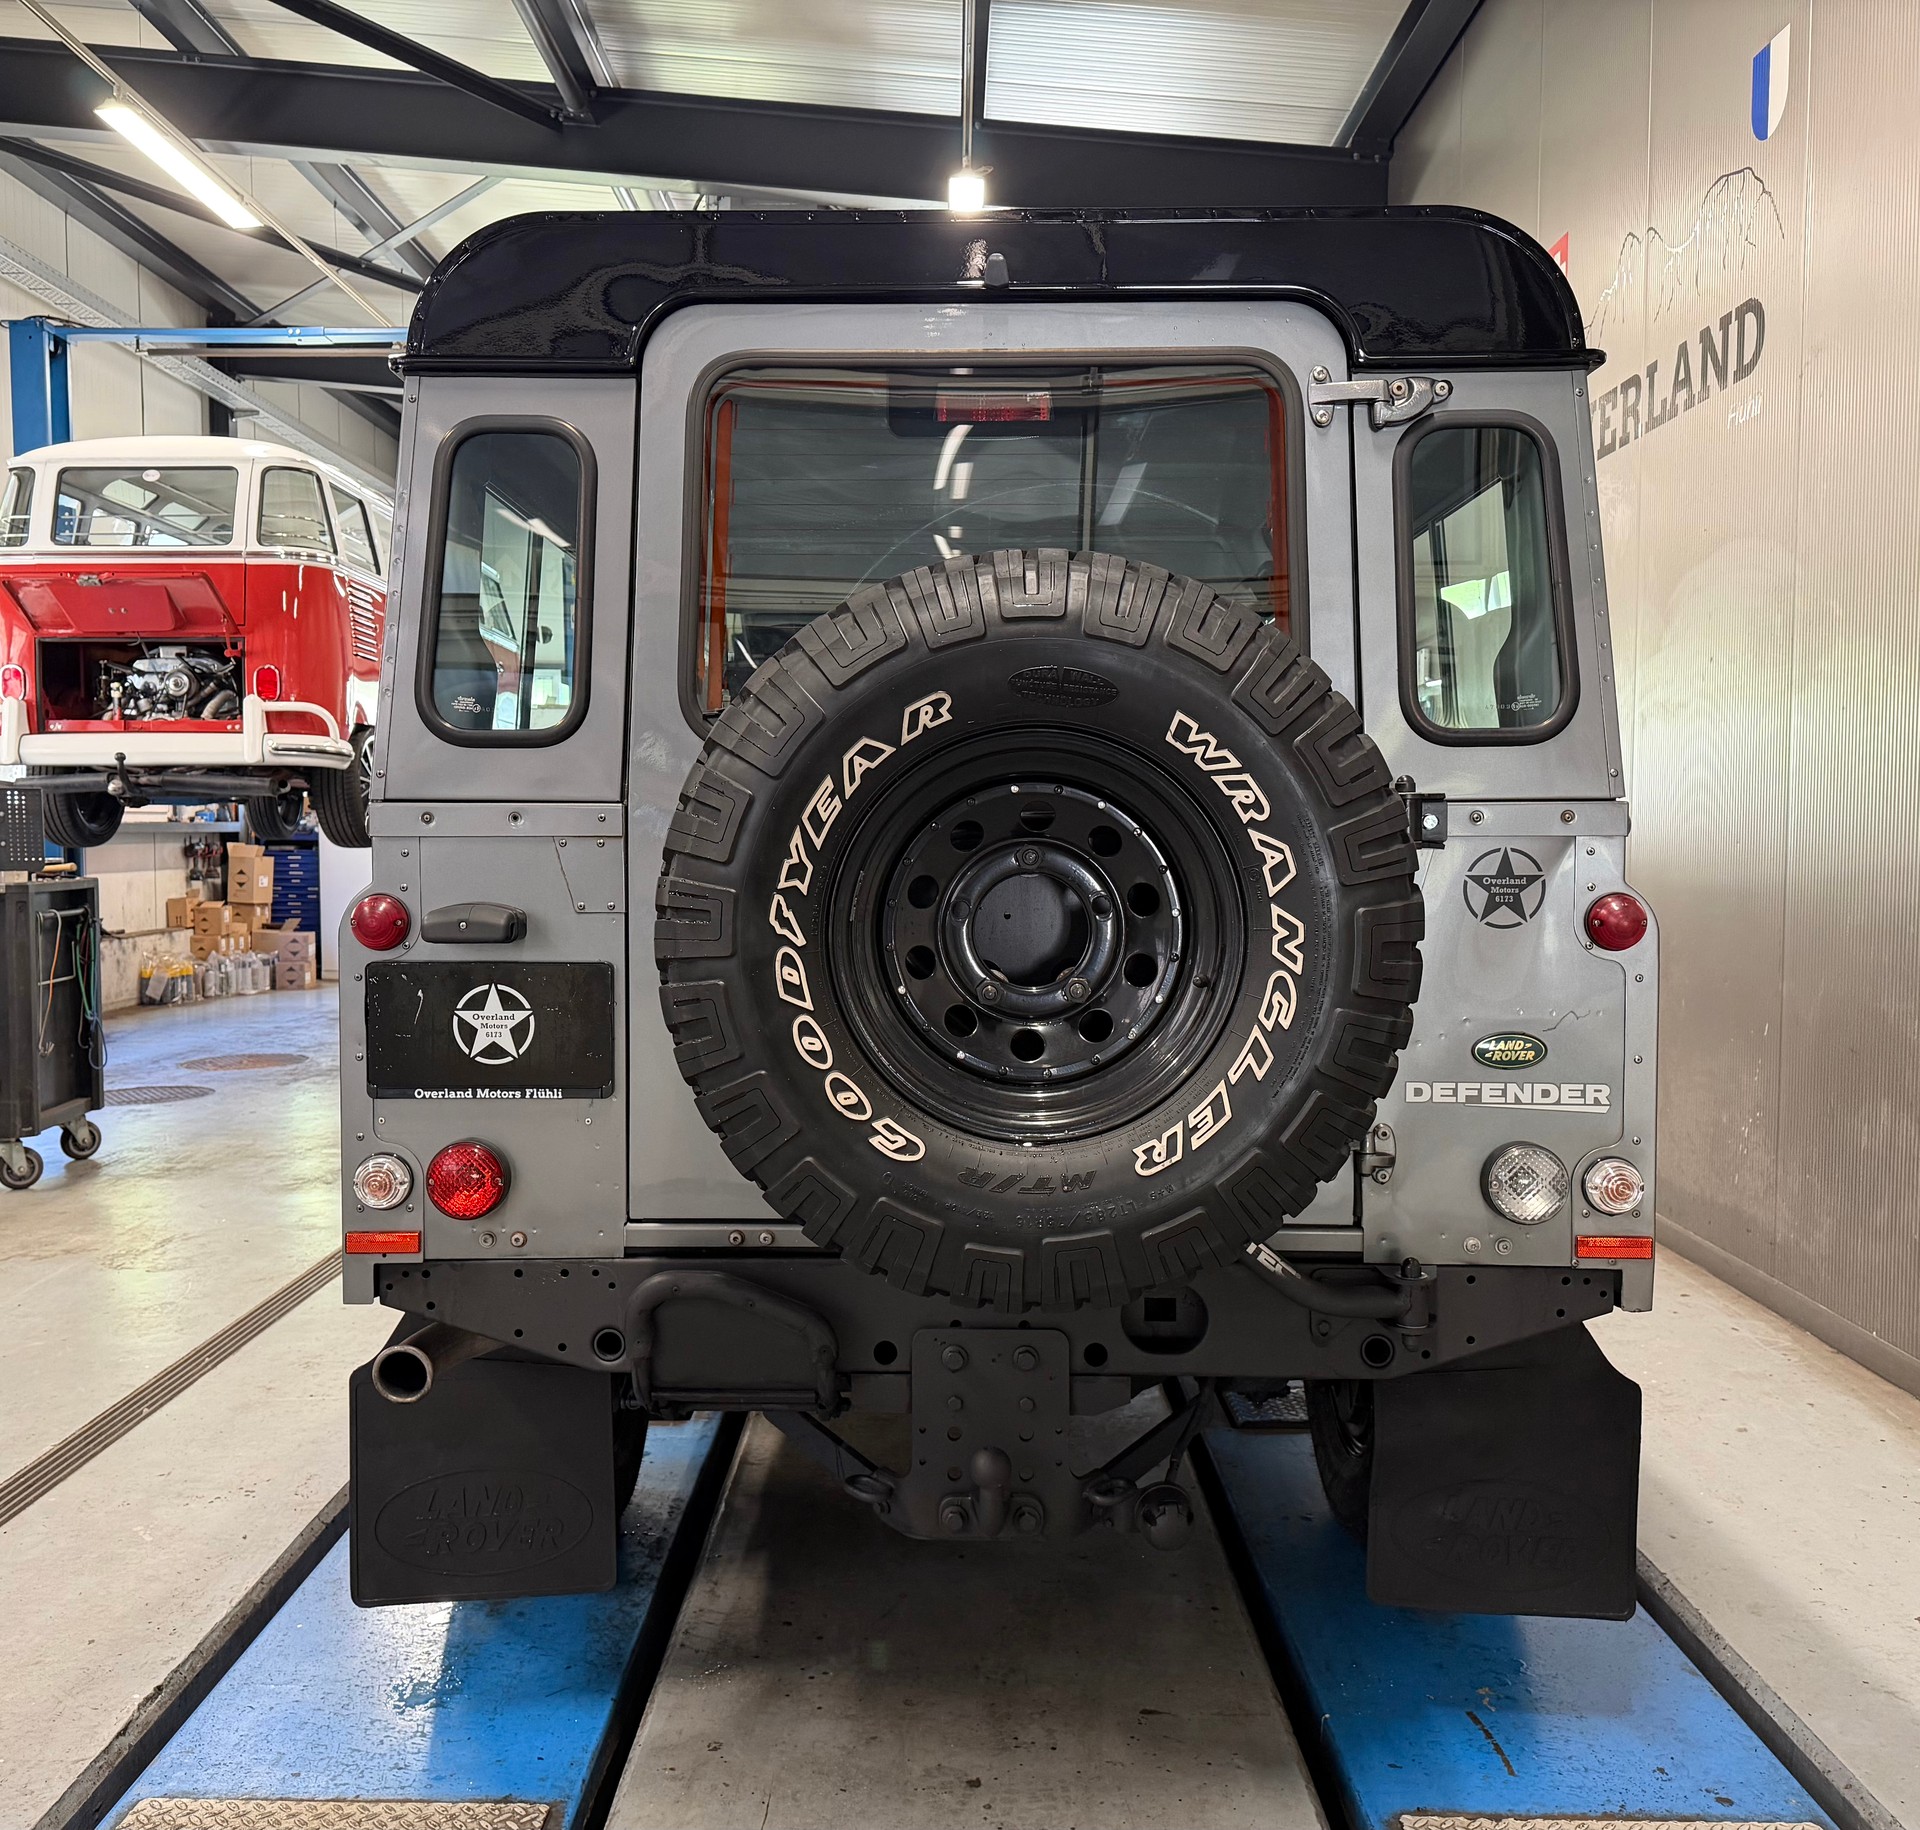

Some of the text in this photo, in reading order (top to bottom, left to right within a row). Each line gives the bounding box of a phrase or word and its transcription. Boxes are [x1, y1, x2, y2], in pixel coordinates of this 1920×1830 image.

[1483, 876, 1527, 885] Overland
[1490, 886, 1519, 894] Motors
[1495, 895, 1514, 903] 6173
[771, 690, 953, 1162] GOODYEAR
[1135, 710, 1305, 1177] WRANGLER
[472, 1012, 515, 1021] Overland
[480, 1022, 508, 1030] Motors
[485, 1031, 503, 1039] 6173
[1489, 1039, 1525, 1050] LAND
[1492, 1050, 1535, 1061] ROVER
[414, 1087, 562, 1099] Overland Motors Flühli
[1405, 1081, 1611, 1105] DEFENDER
